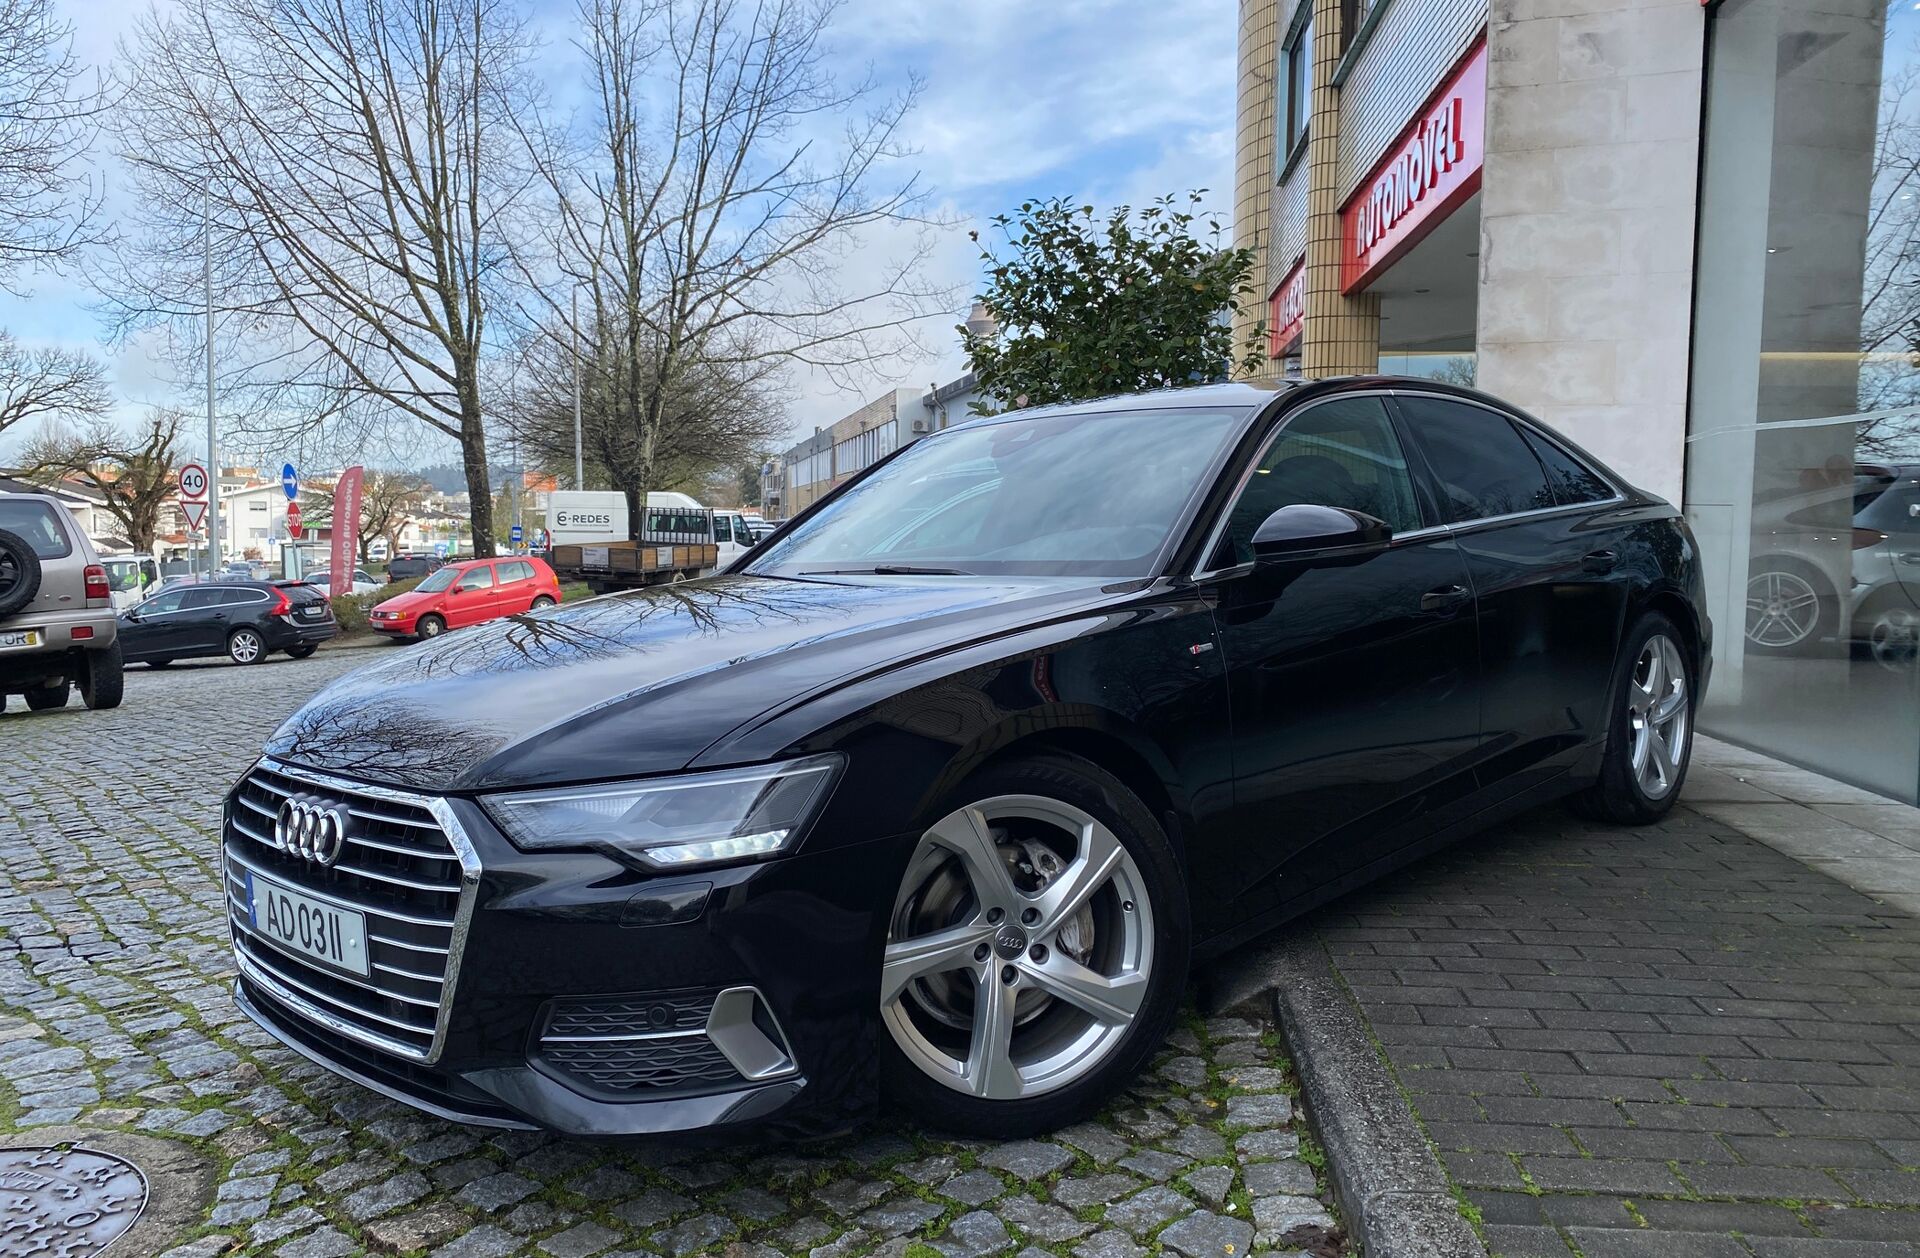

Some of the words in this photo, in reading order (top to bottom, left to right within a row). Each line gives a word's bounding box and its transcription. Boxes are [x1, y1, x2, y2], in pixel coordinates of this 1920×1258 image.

[1356, 98, 1464, 258] AUTOMÓVEL
[183, 474, 203, 488] 40
[287, 513, 303, 527] STOP
